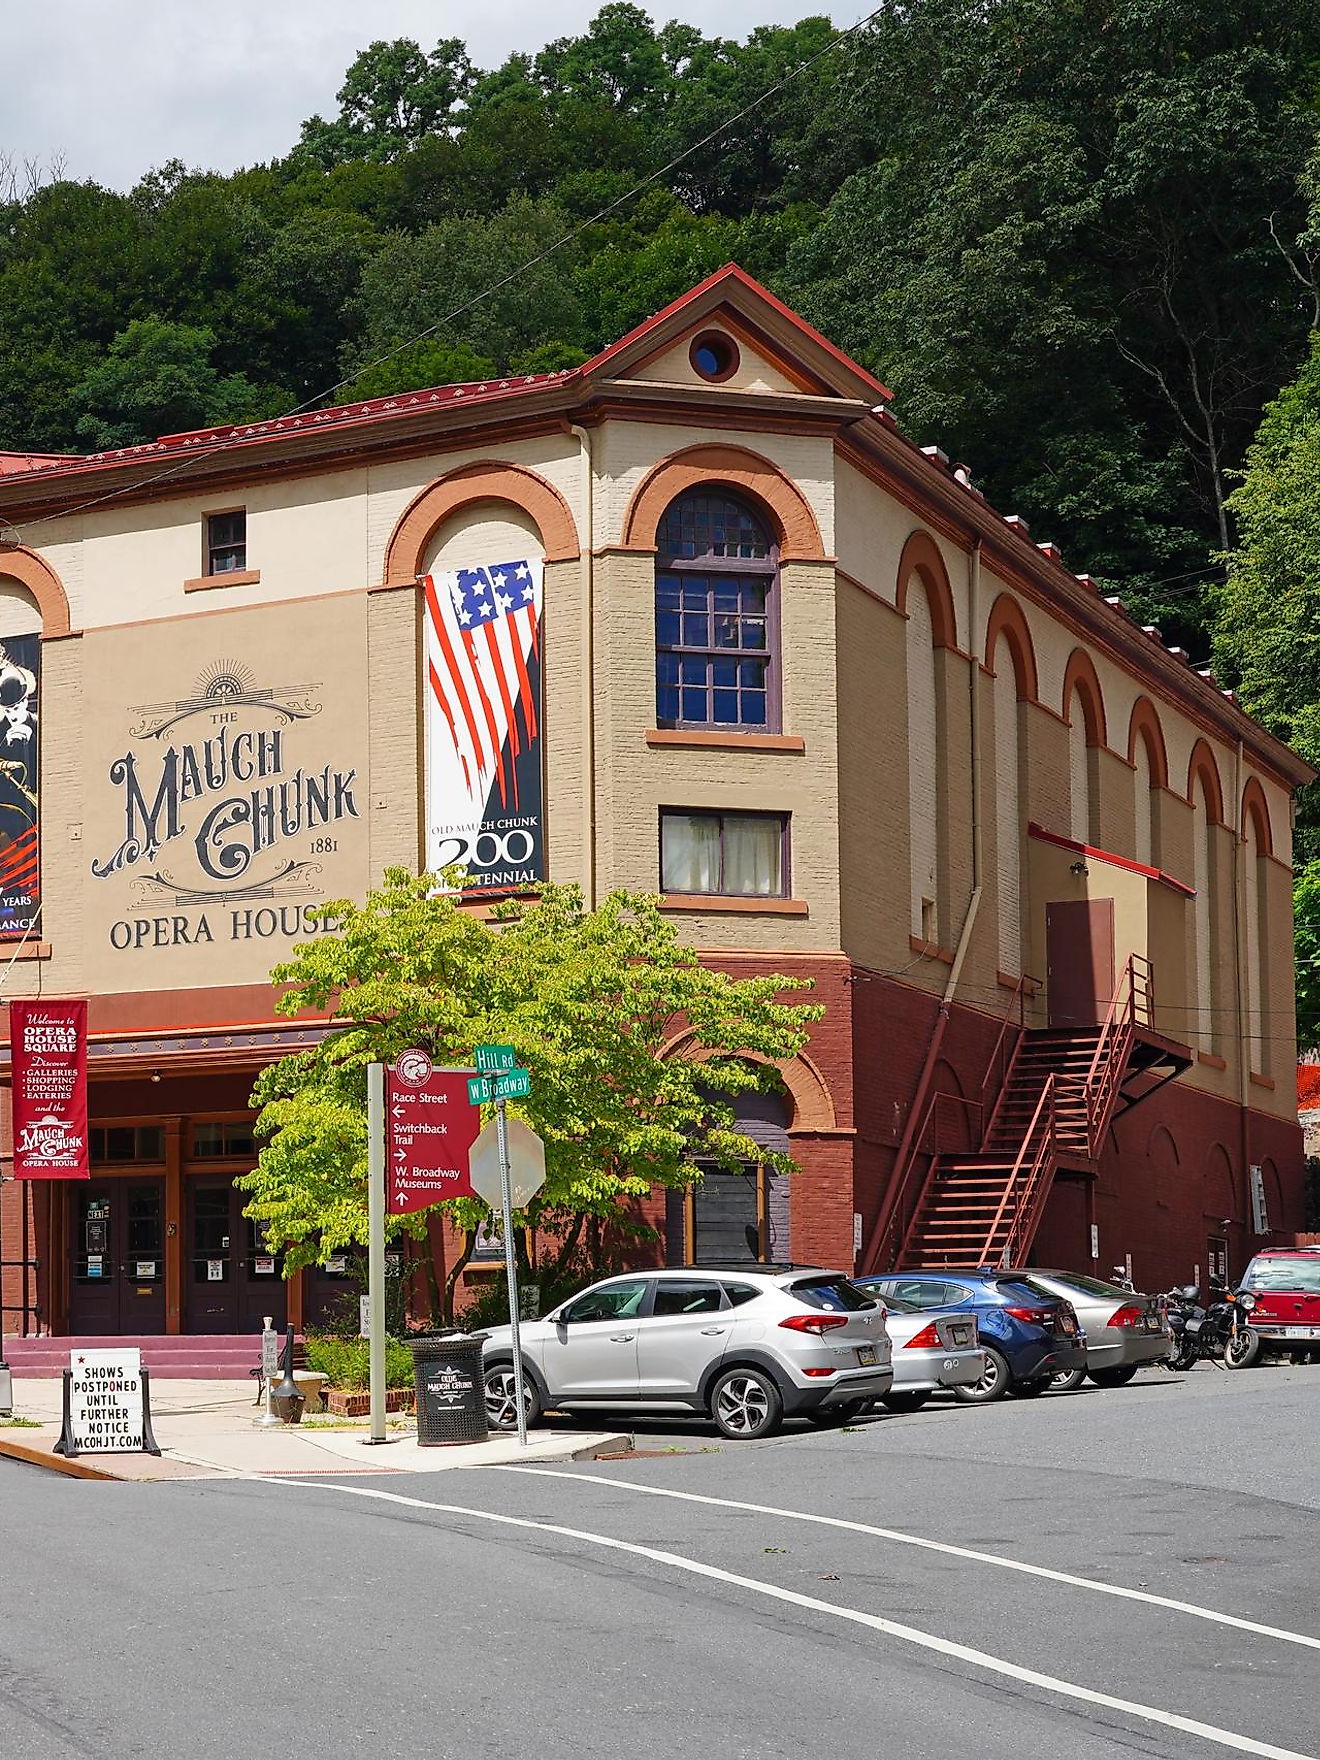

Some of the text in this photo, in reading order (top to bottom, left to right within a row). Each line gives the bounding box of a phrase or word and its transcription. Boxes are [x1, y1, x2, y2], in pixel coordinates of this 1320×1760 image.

[209, 712, 238, 724] THE
[91, 725, 282, 878] MAUCH
[194, 765, 360, 880] CHUNK
[432, 816, 538, 835] OLD MAUCH CHUNK
[310, 837, 338, 854] 1881
[437, 829, 534, 871] 200
[3, 896, 32, 907] YEARS
[110, 903, 341, 950] OPERA HOUSE
[26, 1013, 75, 1025] Welcome to
[23, 1026, 77, 1035] OPERA
[23, 1035, 77, 1044] HOUSE
[23, 1043, 77, 1053] SQUARE
[31, 1055, 69, 1067] Discover
[477, 1050, 514, 1069] Hill Rd
[26, 1069, 78, 1077] GALLERIES
[26, 1084, 72, 1092] LODGING
[470, 1076, 528, 1099] W Broadway
[392, 1092, 448, 1104] Race Street
[34, 1101, 66, 1112] and the
[393, 1122, 448, 1134] Switchback
[16, 1127, 64, 1152] MAUCH
[393, 1135, 413, 1145] Trail
[40, 1136, 83, 1156] CHUNK
[394, 1166, 460, 1181] W. Broadway
[394, 1178, 442, 1190] Museums
[84, 1367, 124, 1379] SHOWS
[74, 1380, 137, 1393] POSTPONED
[86, 1395, 118, 1406] UNTIL
[80, 1408, 129, 1420] FURTHER
[88, 1422, 129, 1434] NOTICE
[73, 1435, 142, 1448] MCOHJT.COM
